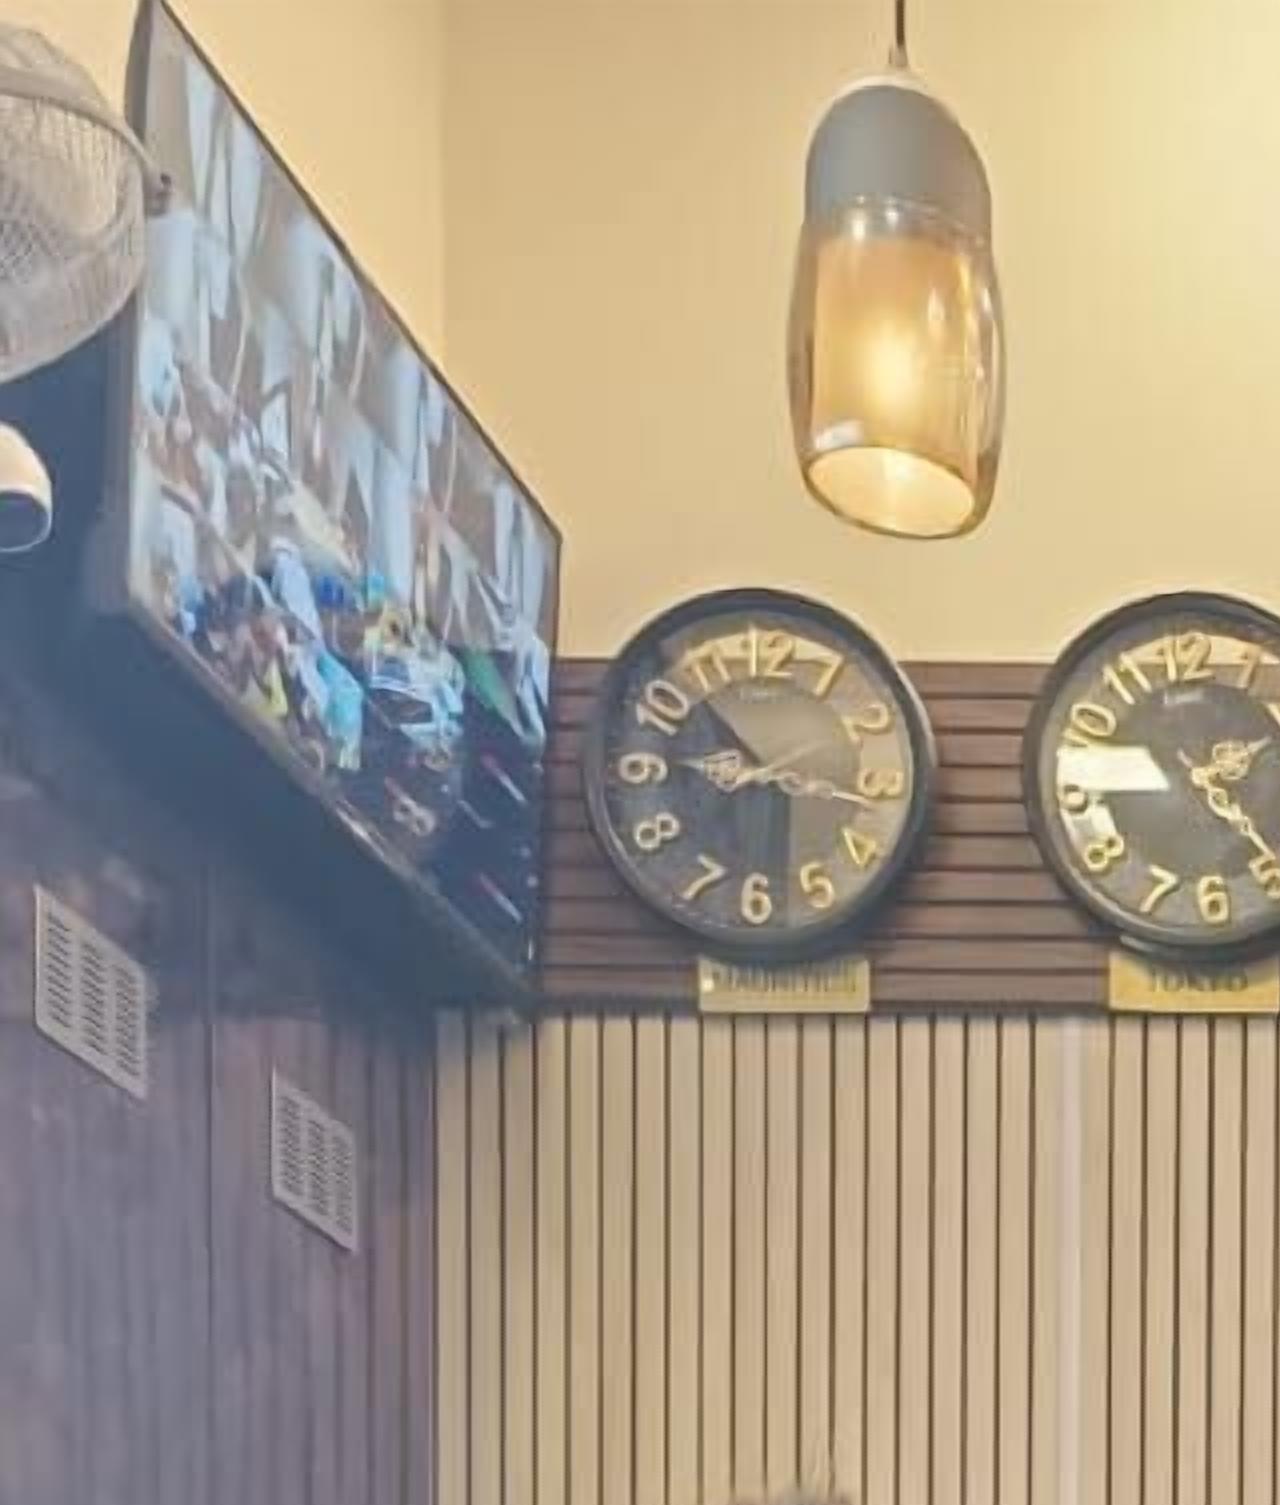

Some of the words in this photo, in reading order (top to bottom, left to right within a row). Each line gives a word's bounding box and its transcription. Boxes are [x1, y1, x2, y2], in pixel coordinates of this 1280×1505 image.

[684, 651, 732, 690] 11
[741, 623, 795, 678] 12
[1159, 633, 1213, 681] 12
[1240, 653, 1262, 688] 1
[813, 654, 845, 698] 1
[1103, 653, 1151, 704] 11
[636, 680, 690, 735] 10
[840, 704, 891, 747] 2
[1063, 703, 1116, 747] 10
[619, 753, 667, 784] 9
[858, 770, 904, 799] 3
[634, 812, 680, 849] 8
[842, 828, 877, 864] 4
[1085, 833, 1124, 871] 8
[681, 854, 725, 901] 7
[741, 872, 772, 924] 6
[800, 863, 834, 908] 5
[1139, 864, 1179, 912] 7
[1198, 875, 1230, 923] 6
